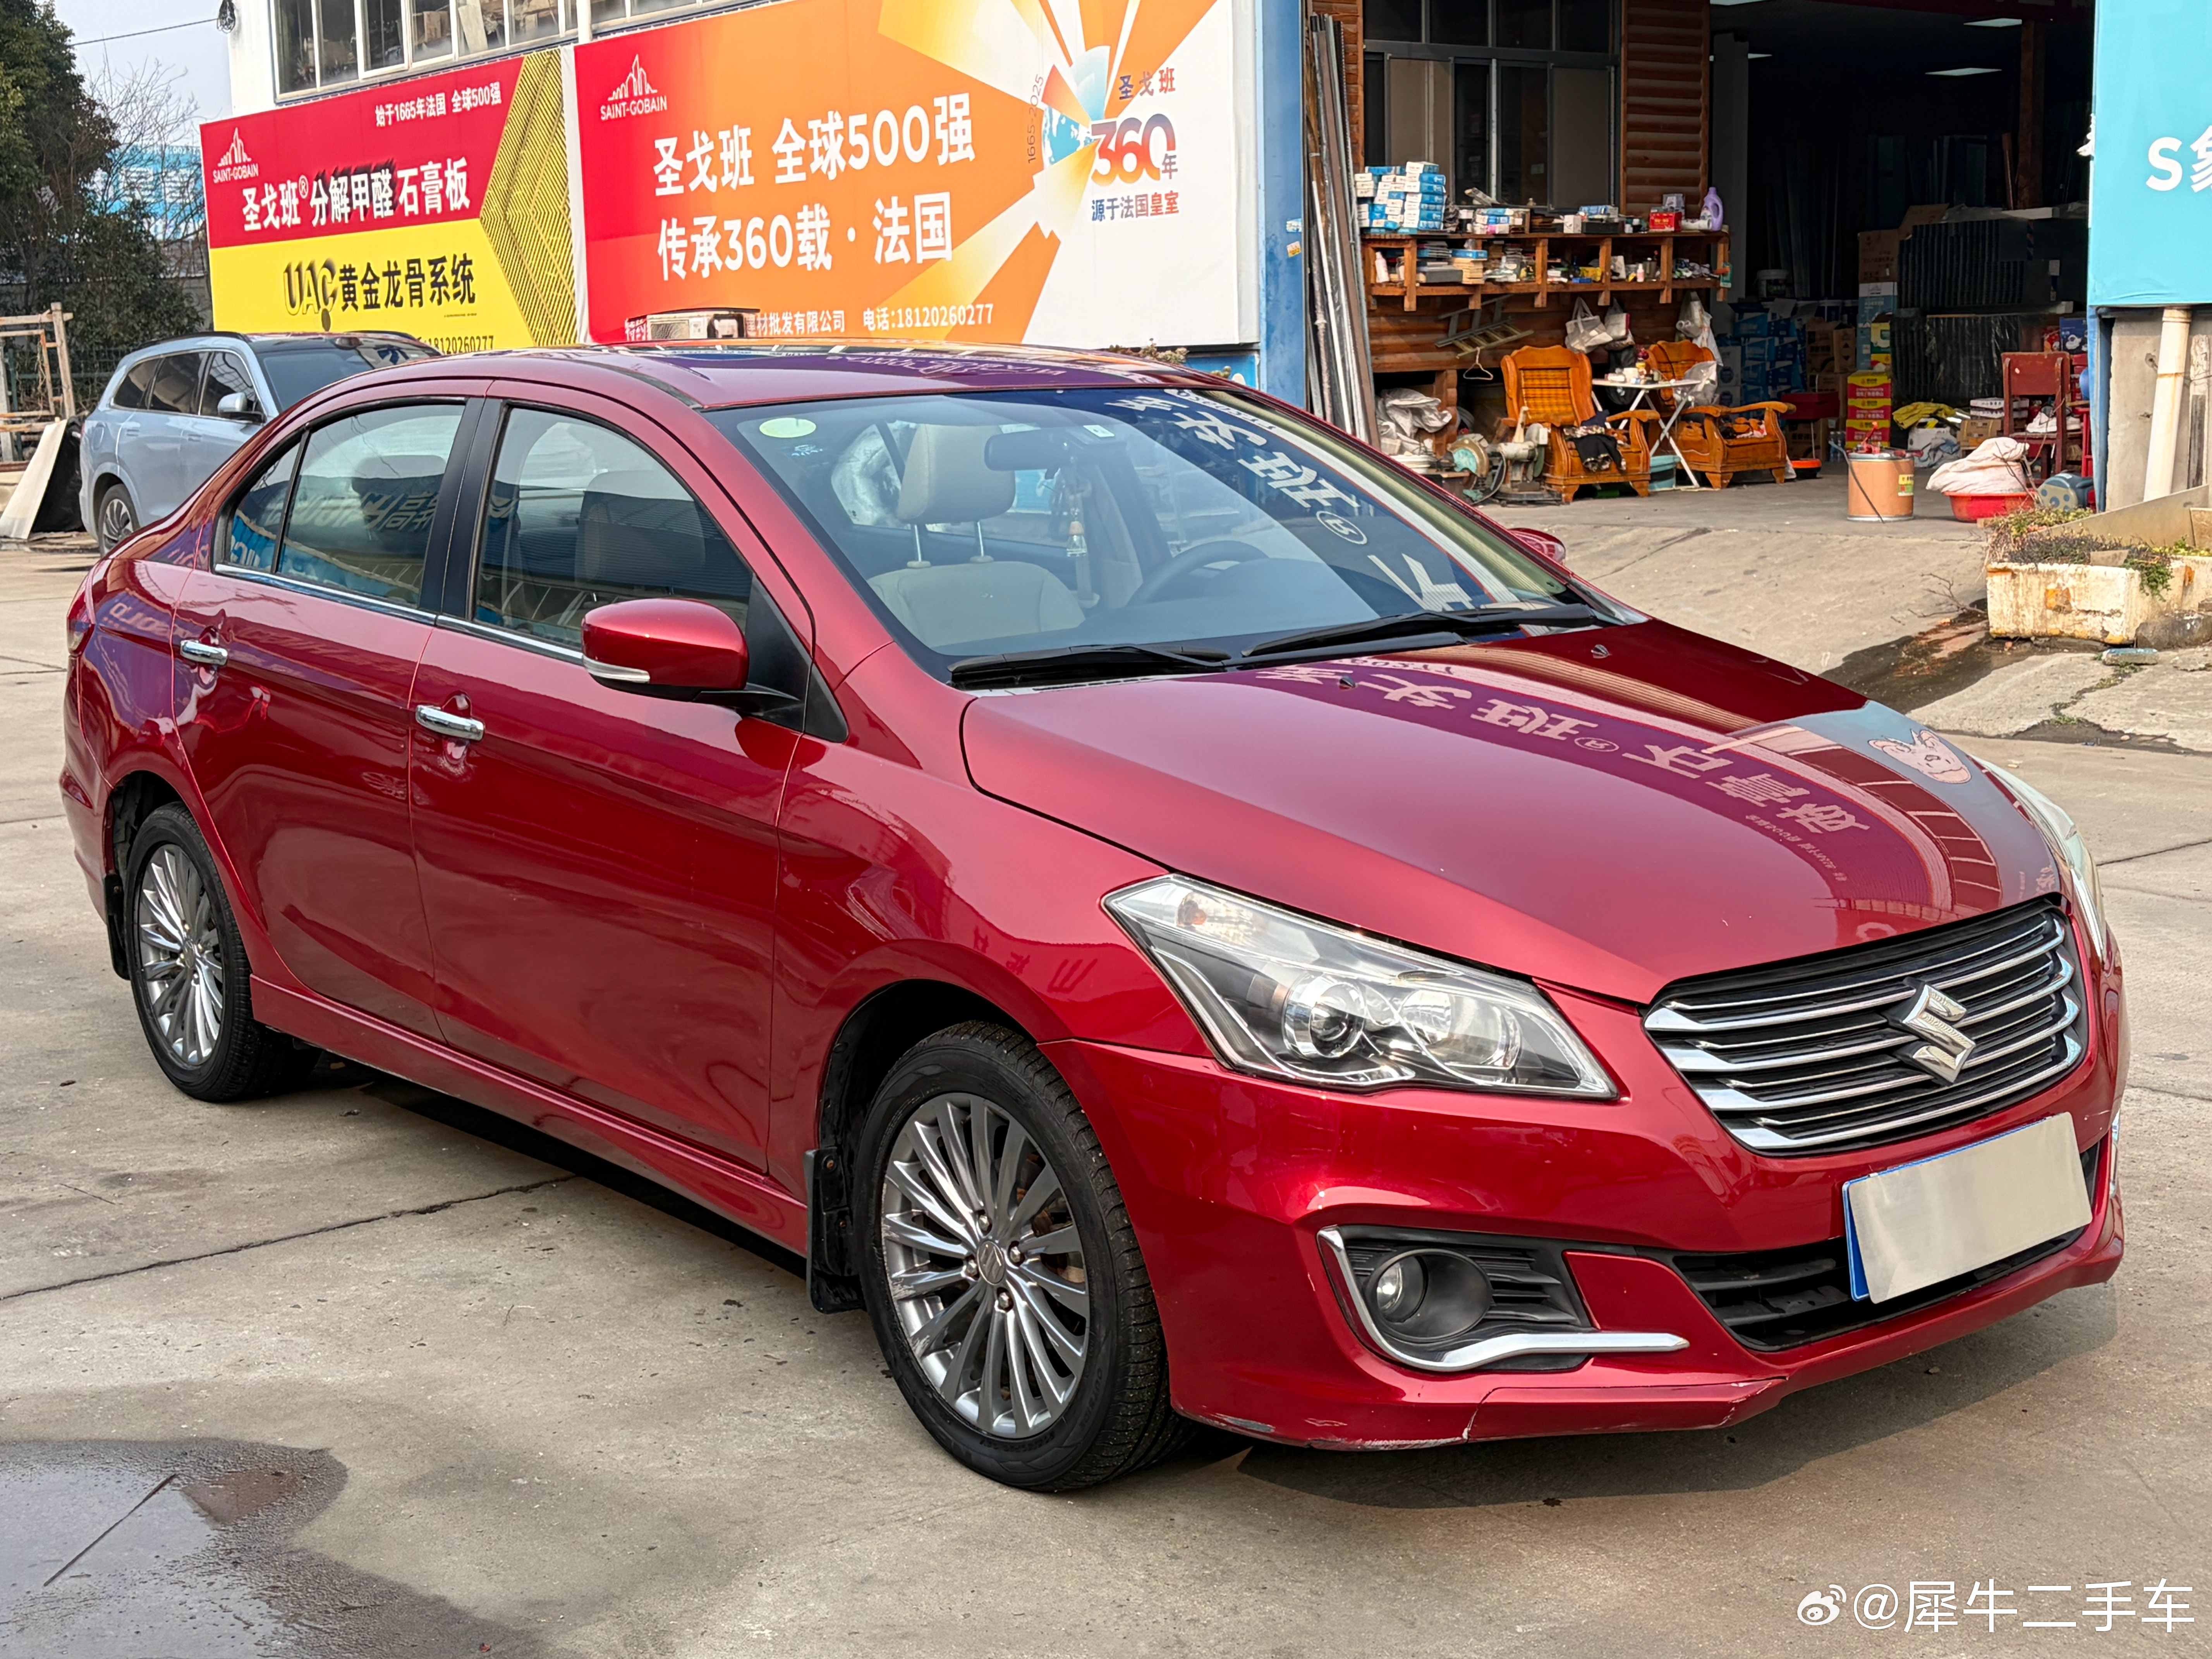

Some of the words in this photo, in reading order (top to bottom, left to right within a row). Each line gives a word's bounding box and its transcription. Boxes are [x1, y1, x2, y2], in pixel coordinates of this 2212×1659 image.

[1119, 67, 1175, 100] 圣戈班
[375, 93, 446, 127] 始于1665年法国
[452, 81, 502, 113] 全球500强
[600, 95, 667, 121] SAINT-GOBAIN
[1027, 74, 1044, 163] 1665-2025
[653, 124, 754, 196] 圣戈班
[772, 92, 975, 184] 全球500强
[1091, 113, 1178, 186] 360年
[213, 163, 259, 184] SAINT-GOBAIN
[1092, 190, 1179, 222] 源于法国皇室
